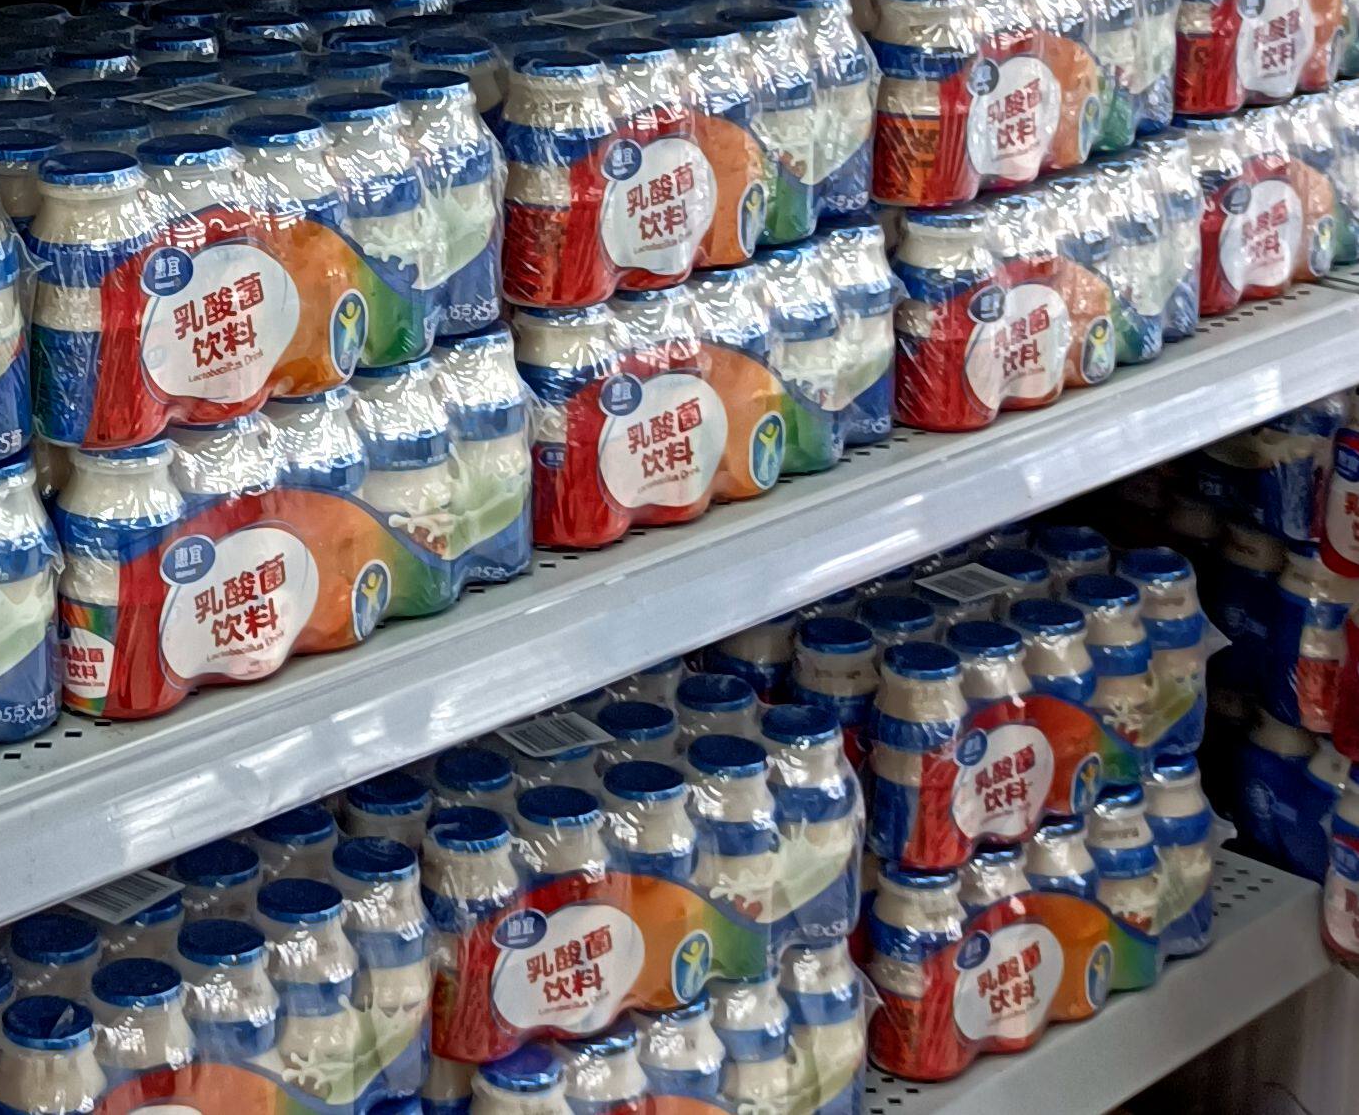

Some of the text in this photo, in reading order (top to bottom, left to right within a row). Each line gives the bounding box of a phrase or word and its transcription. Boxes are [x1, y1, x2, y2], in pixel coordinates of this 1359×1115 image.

[639, 198, 689, 241] 饮料
[173, 272, 266, 341] 乳酸菌
[192, 313, 258, 370] 饮料
[628, 397, 703, 455] 乳酸菌
[642, 435, 694, 479] 饮料
[175, 544, 203, 568] 惠宜
[194, 553, 287, 624] 乳酸菌
[211, 598, 279, 649] 饮料
[527, 924, 614, 984] 乳酸菌
[543, 963, 604, 1003] 饮料
